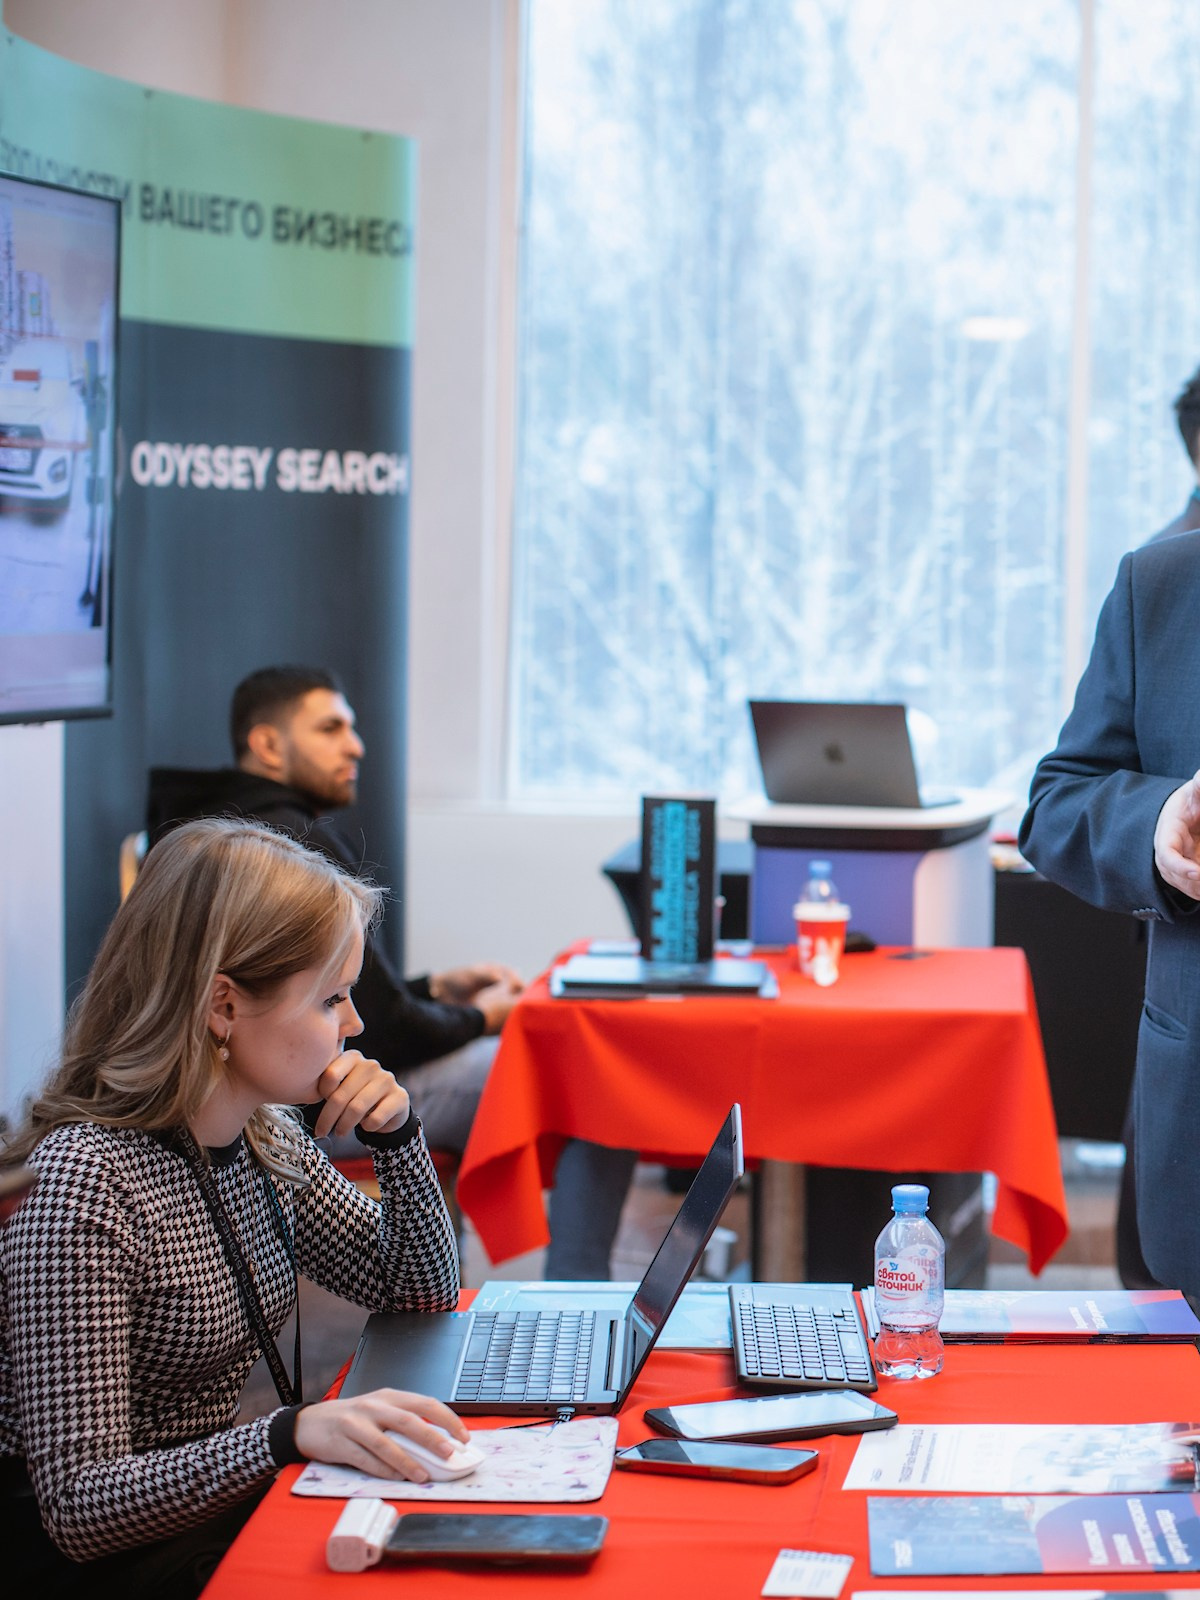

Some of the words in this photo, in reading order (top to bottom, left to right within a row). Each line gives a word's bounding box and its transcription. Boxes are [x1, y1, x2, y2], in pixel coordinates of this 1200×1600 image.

[140, 182, 263, 240] ВАШЕГО
[272, 204, 412, 260] БИЗНЕС
[131, 440, 273, 491] ODYSSEY
[276, 448, 409, 495] SEARCH
